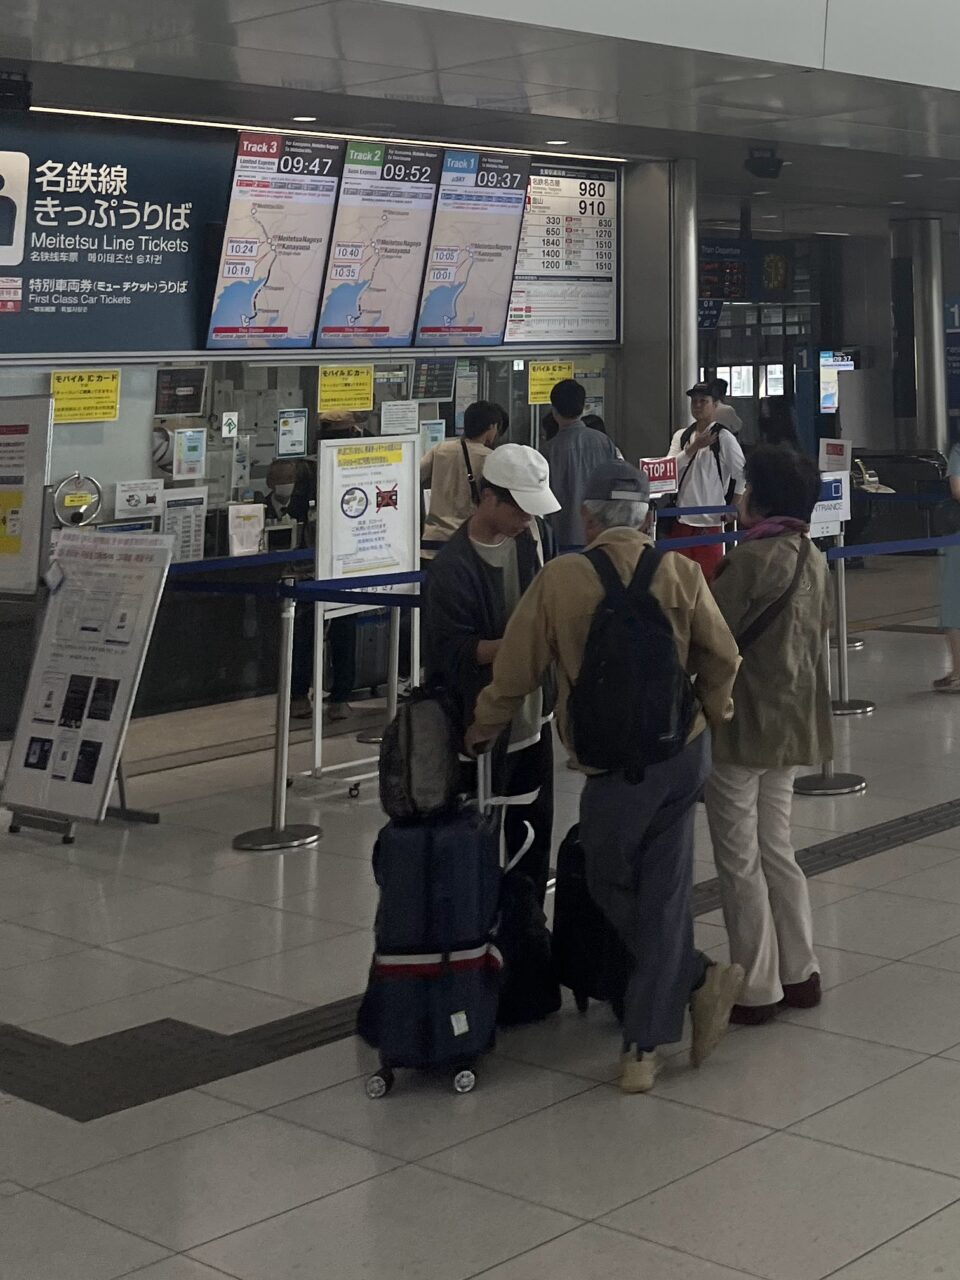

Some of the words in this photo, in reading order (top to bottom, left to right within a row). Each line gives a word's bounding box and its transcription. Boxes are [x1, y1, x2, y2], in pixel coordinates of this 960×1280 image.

[243, 141, 268, 153] Track
[270, 141, 277, 153] 3
[350, 150, 372, 161] Track
[373, 150, 381, 161] 2
[280, 155, 332, 175] 09:47
[447, 158, 468, 168] Track
[471, 158, 475, 169] 1
[35, 159, 128, 196] 名鉄線
[383, 164, 431, 182] 09:52
[477, 171, 521, 188] 09:37
[579, 181, 606, 198] 980
[34, 196, 193, 231] きっぷうりば
[579, 200, 605, 216] 910
[546, 217, 560, 225] 330
[598, 220, 612, 228] 830
[546, 228, 560, 236] 650
[595, 230, 612, 238] 1270
[31, 232, 98, 250] Meitetsu
[103, 234, 135, 251] Line
[138, 235, 189, 253] Tickets
[542, 238, 560, 247] 1840
[596, 241, 612, 249] 1510
[542, 249, 560, 258] 1400
[596, 251, 612, 260] 1510
[542, 260, 560, 269] 1200
[596, 262, 612, 270] 1510
[29, 294, 49, 305] First
[52, 294, 79, 304] Class
[81, 294, 98, 304] Car
[100, 294, 131, 305] Tickets
[950, 304, 960, 326] 1
[643, 463, 665, 477] STOP
[814, 502, 842, 513] NTRANCE
